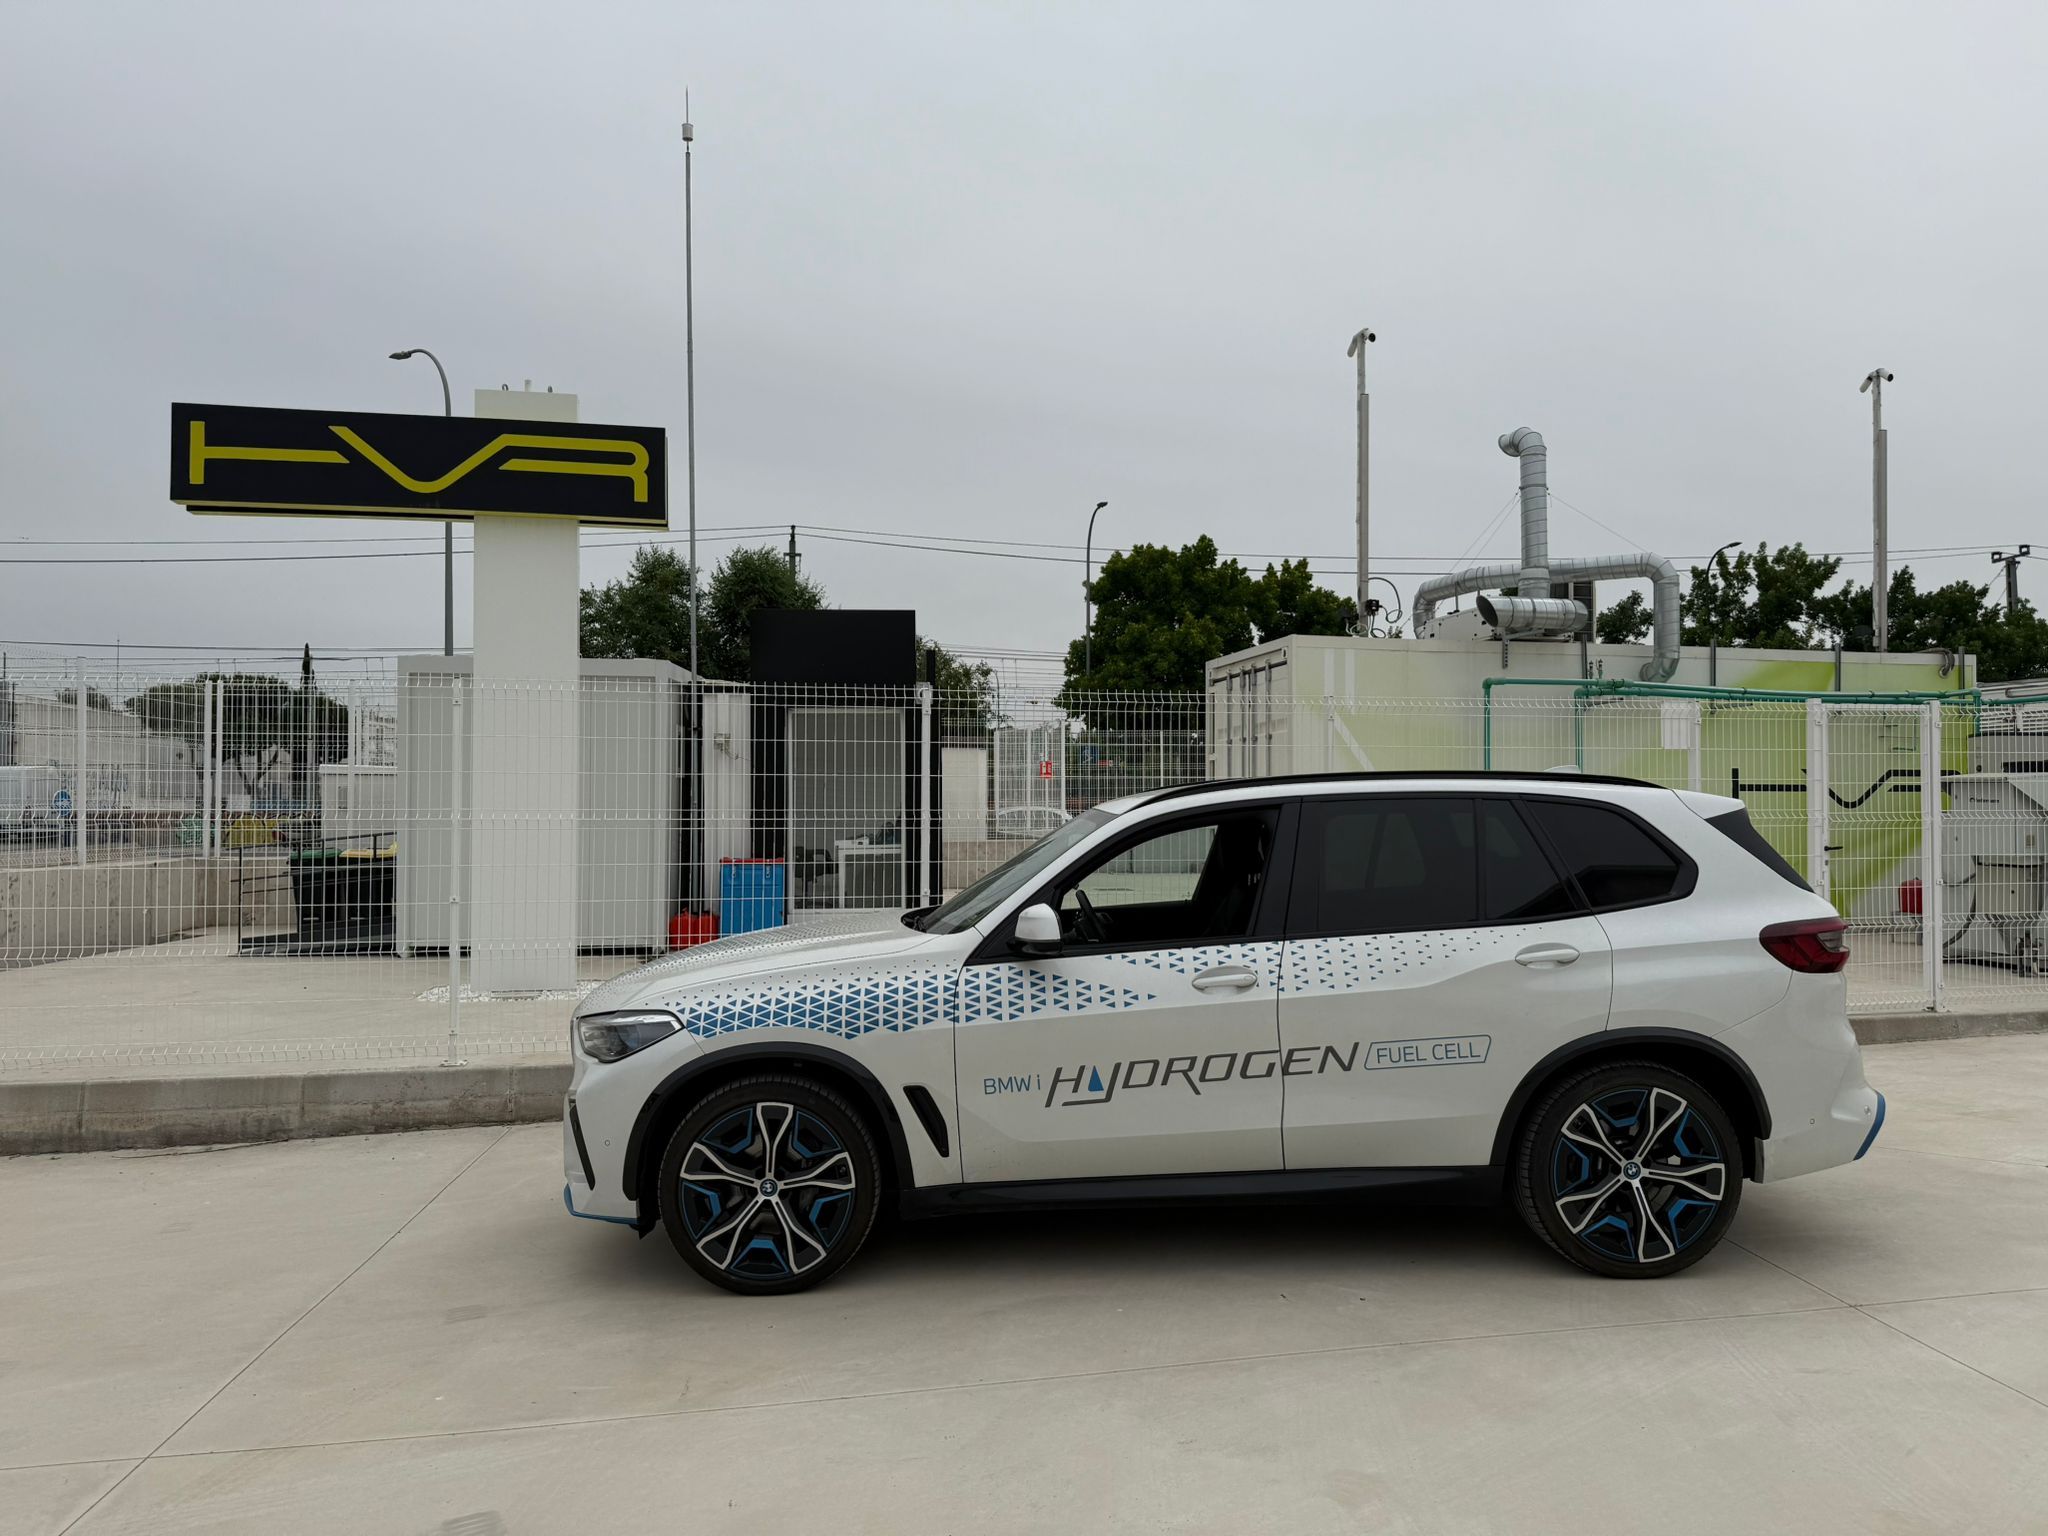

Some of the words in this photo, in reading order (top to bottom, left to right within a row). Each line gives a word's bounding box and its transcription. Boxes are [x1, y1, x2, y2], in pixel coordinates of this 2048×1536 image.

[983, 1074, 1032, 1095] BMW
[1045, 1042, 1360, 1108] HYDROGEN
[1376, 1045, 1428, 1064] FUEL
[1432, 1041, 1482, 1061] CELL
